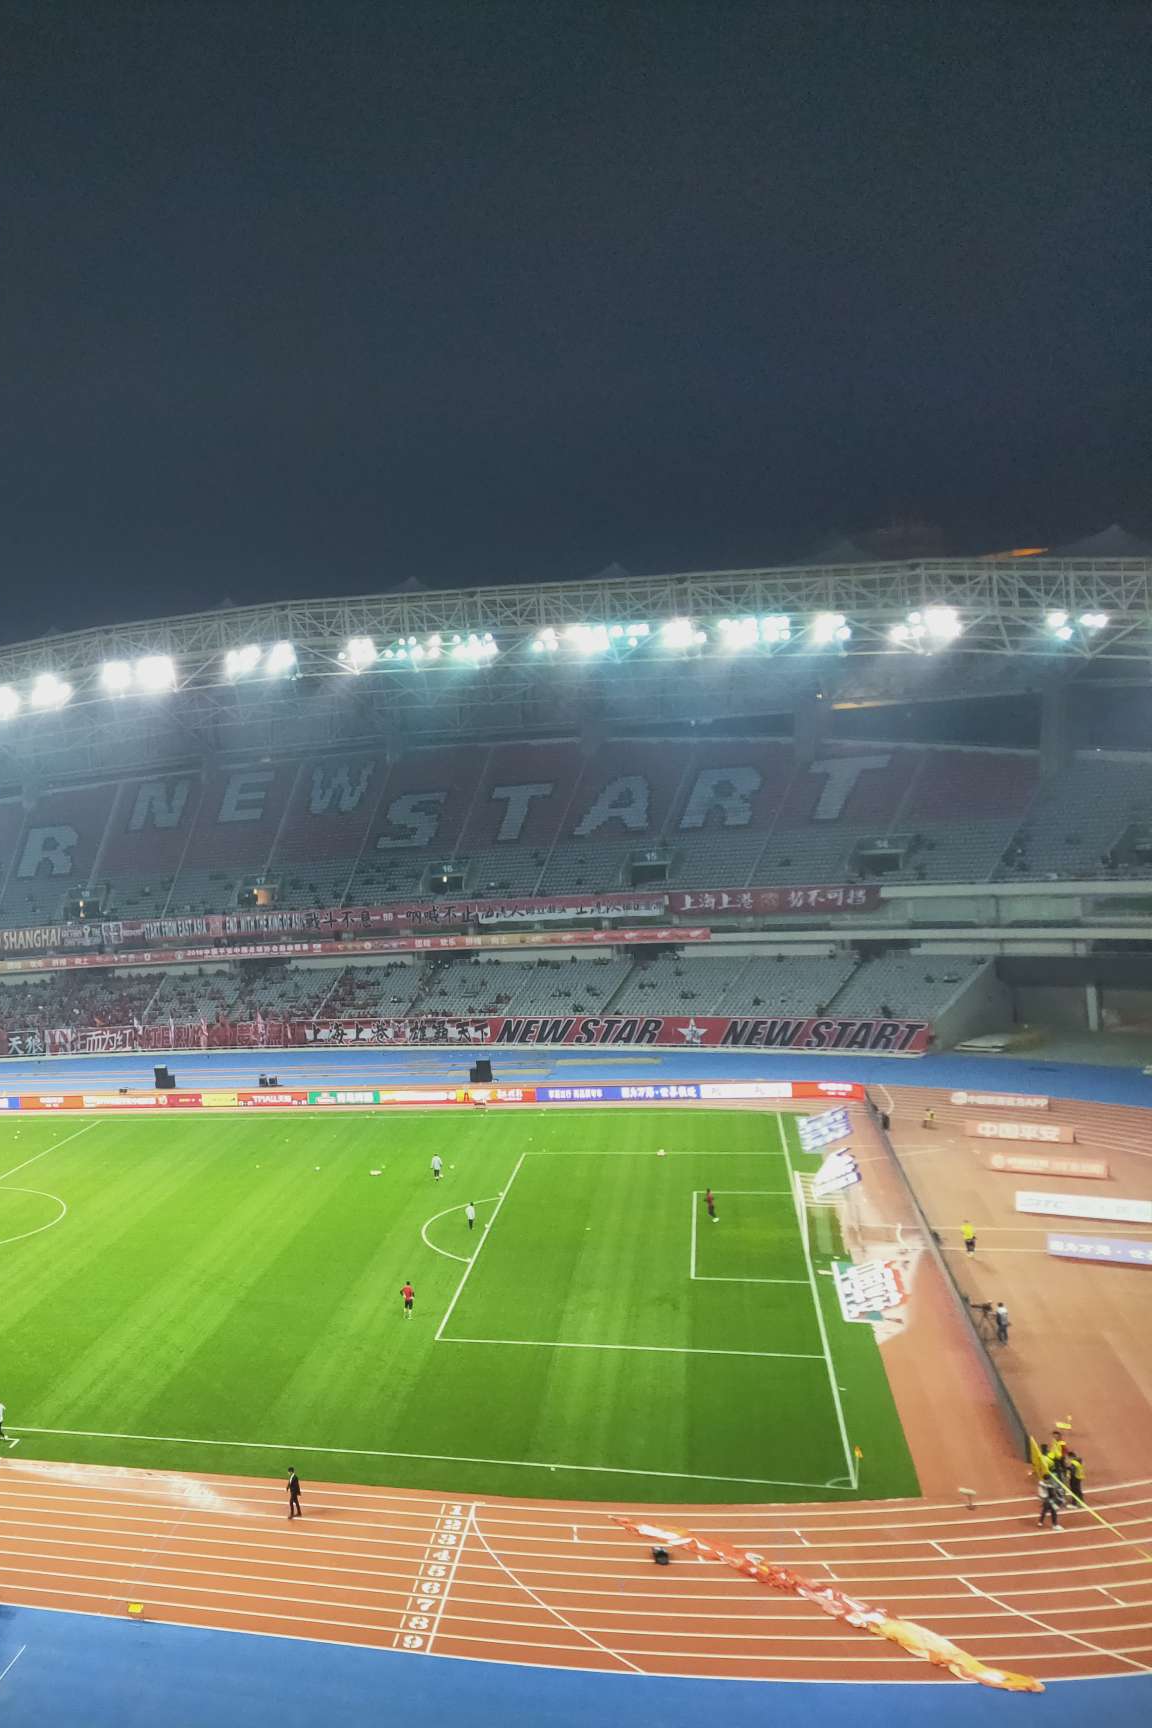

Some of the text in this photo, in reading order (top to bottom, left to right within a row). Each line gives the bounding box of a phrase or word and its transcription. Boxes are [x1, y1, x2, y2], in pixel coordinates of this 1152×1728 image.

[127, 759, 375, 832] NEW
[376, 754, 892, 848] START
[680, 891, 754, 911] 上海上港
[3, 928, 61, 950] SHANGHAI
[495, 1016, 925, 1052] NEW STAR NEW START
[8, 1036, 45, 1056] 天狼
[451, 1505, 462, 1516] 1
[443, 1519, 462, 1530] 2
[438, 1534, 456, 1545] 3
[433, 1549, 451, 1561] 4
[427, 1565, 446, 1577] 5
[421, 1582, 440, 1594] 6
[416, 1598, 435, 1611] 7
[408, 1616, 429, 1630] 8
[402, 1634, 423, 1648] 9
